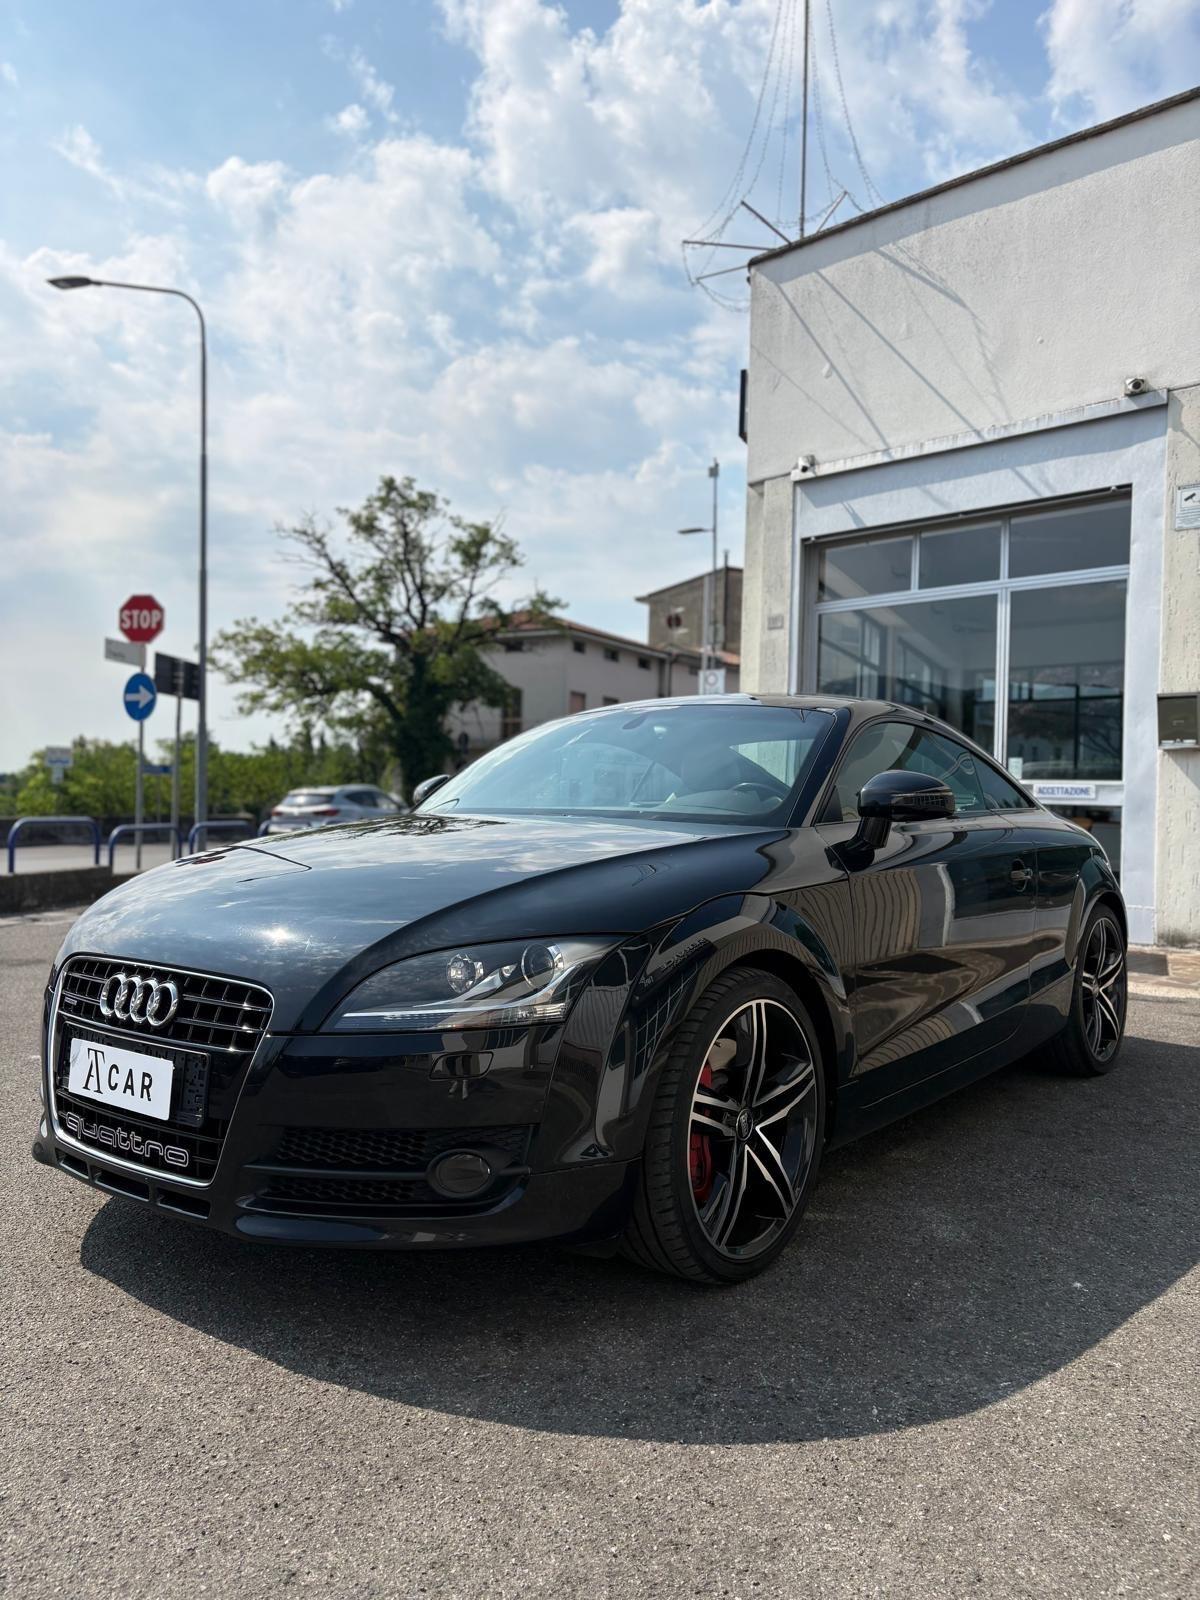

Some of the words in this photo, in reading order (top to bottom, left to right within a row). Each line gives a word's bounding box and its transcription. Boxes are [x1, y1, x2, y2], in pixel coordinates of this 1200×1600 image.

[120, 609, 161, 629] STOP
[1038, 786, 1090, 796] ACCETTAZIONE
[107, 1063, 153, 1102] CAR
[66, 1111, 190, 1167] quattro
